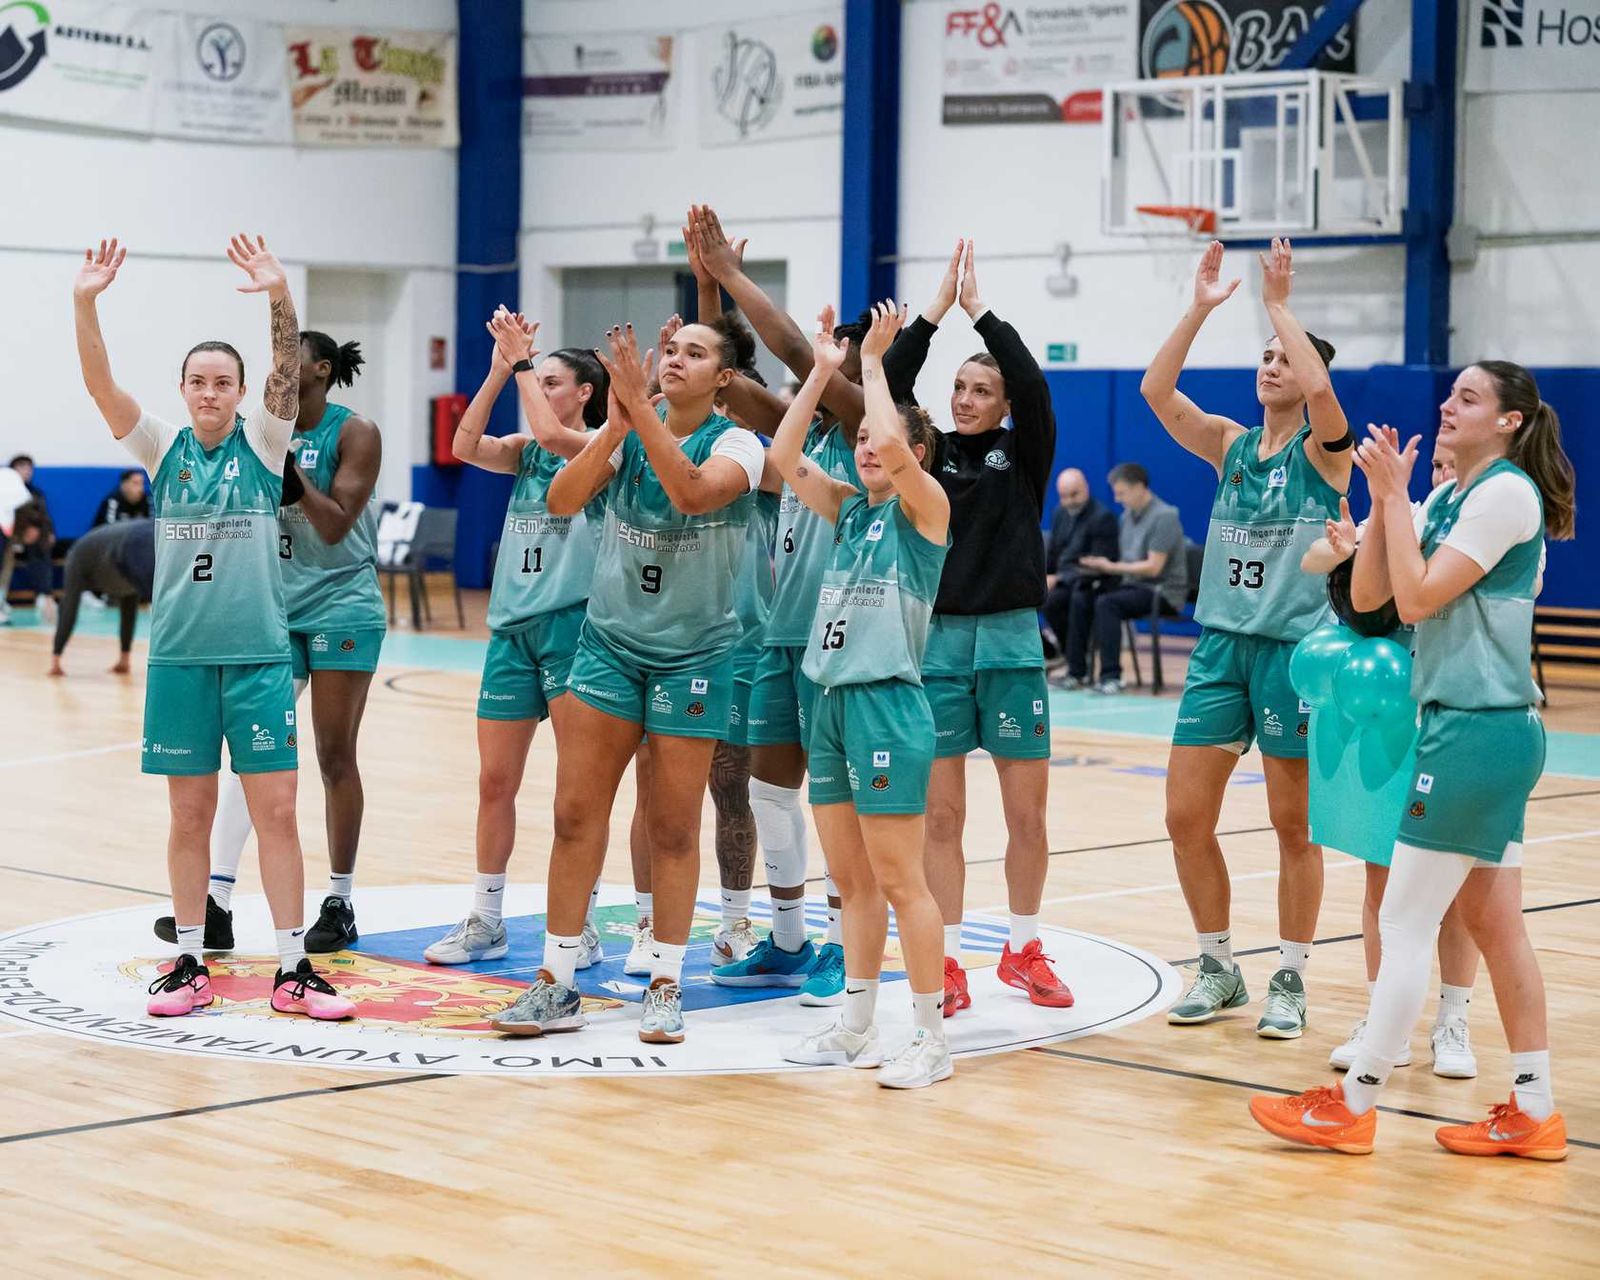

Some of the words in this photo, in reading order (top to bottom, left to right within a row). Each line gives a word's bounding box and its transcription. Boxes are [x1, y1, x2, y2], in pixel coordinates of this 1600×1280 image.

[279, 535, 293, 560] 3
[783, 527, 795, 554] 6
[192, 554, 213, 583] 2
[521, 546, 543, 574] 11
[1228, 558, 1265, 589] 33
[640, 564, 664, 595] 9
[822, 619, 848, 651] 15
[29, 1005, 460, 1065] AYUNTAMIENTO
[480, 1055, 668, 1068] ILMO.
